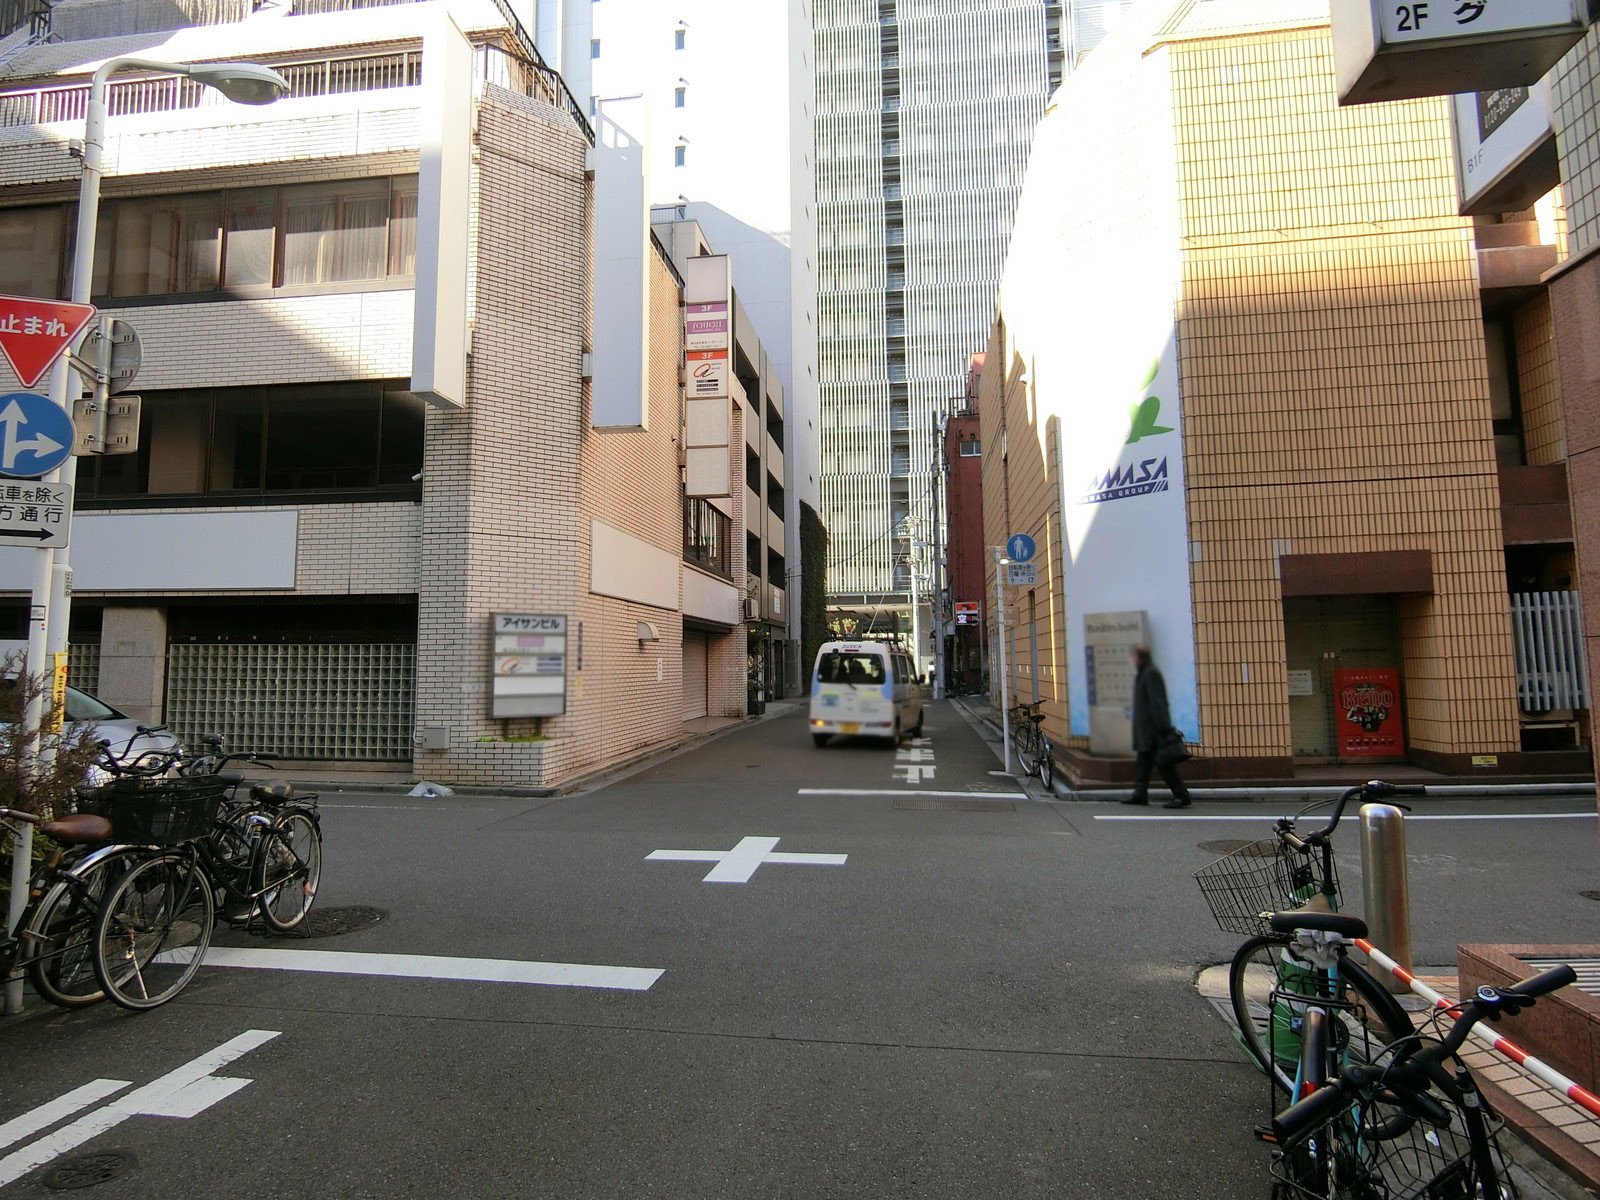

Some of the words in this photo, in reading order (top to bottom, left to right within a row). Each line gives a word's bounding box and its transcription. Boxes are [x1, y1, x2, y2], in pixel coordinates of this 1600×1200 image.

[1396, 3, 1428, 31] 2F
[1466, 148, 1484, 174] B1F
[0, 313, 69, 337] 止まれ
[0, 484, 64, 504] 車を除く
[1118, 485, 1150, 497] GROUP
[503, 617, 560, 629] アイサンビル
